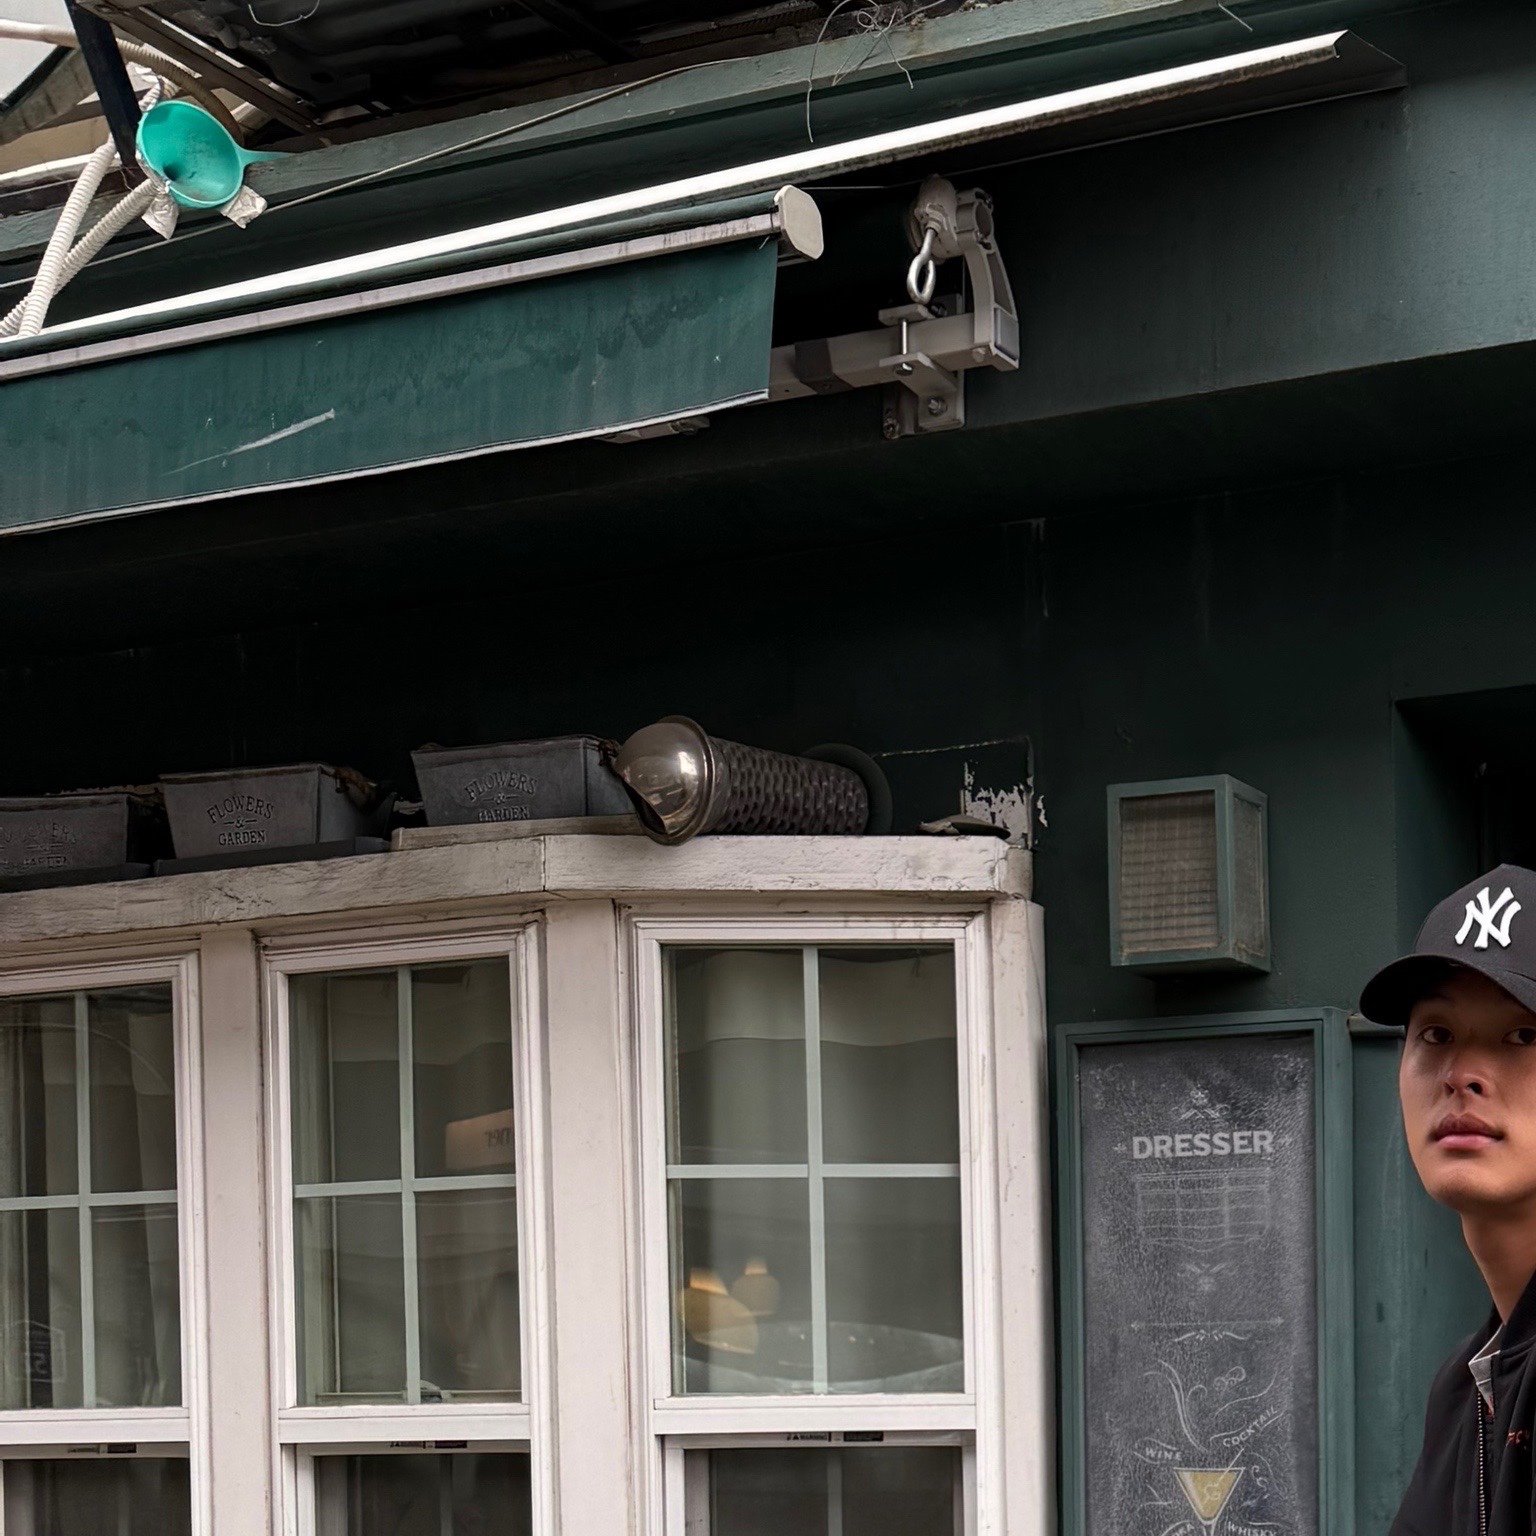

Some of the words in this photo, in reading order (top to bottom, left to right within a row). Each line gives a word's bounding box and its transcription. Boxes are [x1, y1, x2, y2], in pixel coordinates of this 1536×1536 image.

[465, 771, 538, 802] FLOWERS
[207, 794, 274, 823] FLOWERS
[478, 805, 531, 822] GARDEN
[235, 816, 244, 829] &
[218, 829, 266, 846] GARDEN
[1132, 1130, 1274, 1159] DRESSER
[1222, 1406, 1278, 1447] COCKTAIL
[1145, 1447, 1182, 1461] WINE
